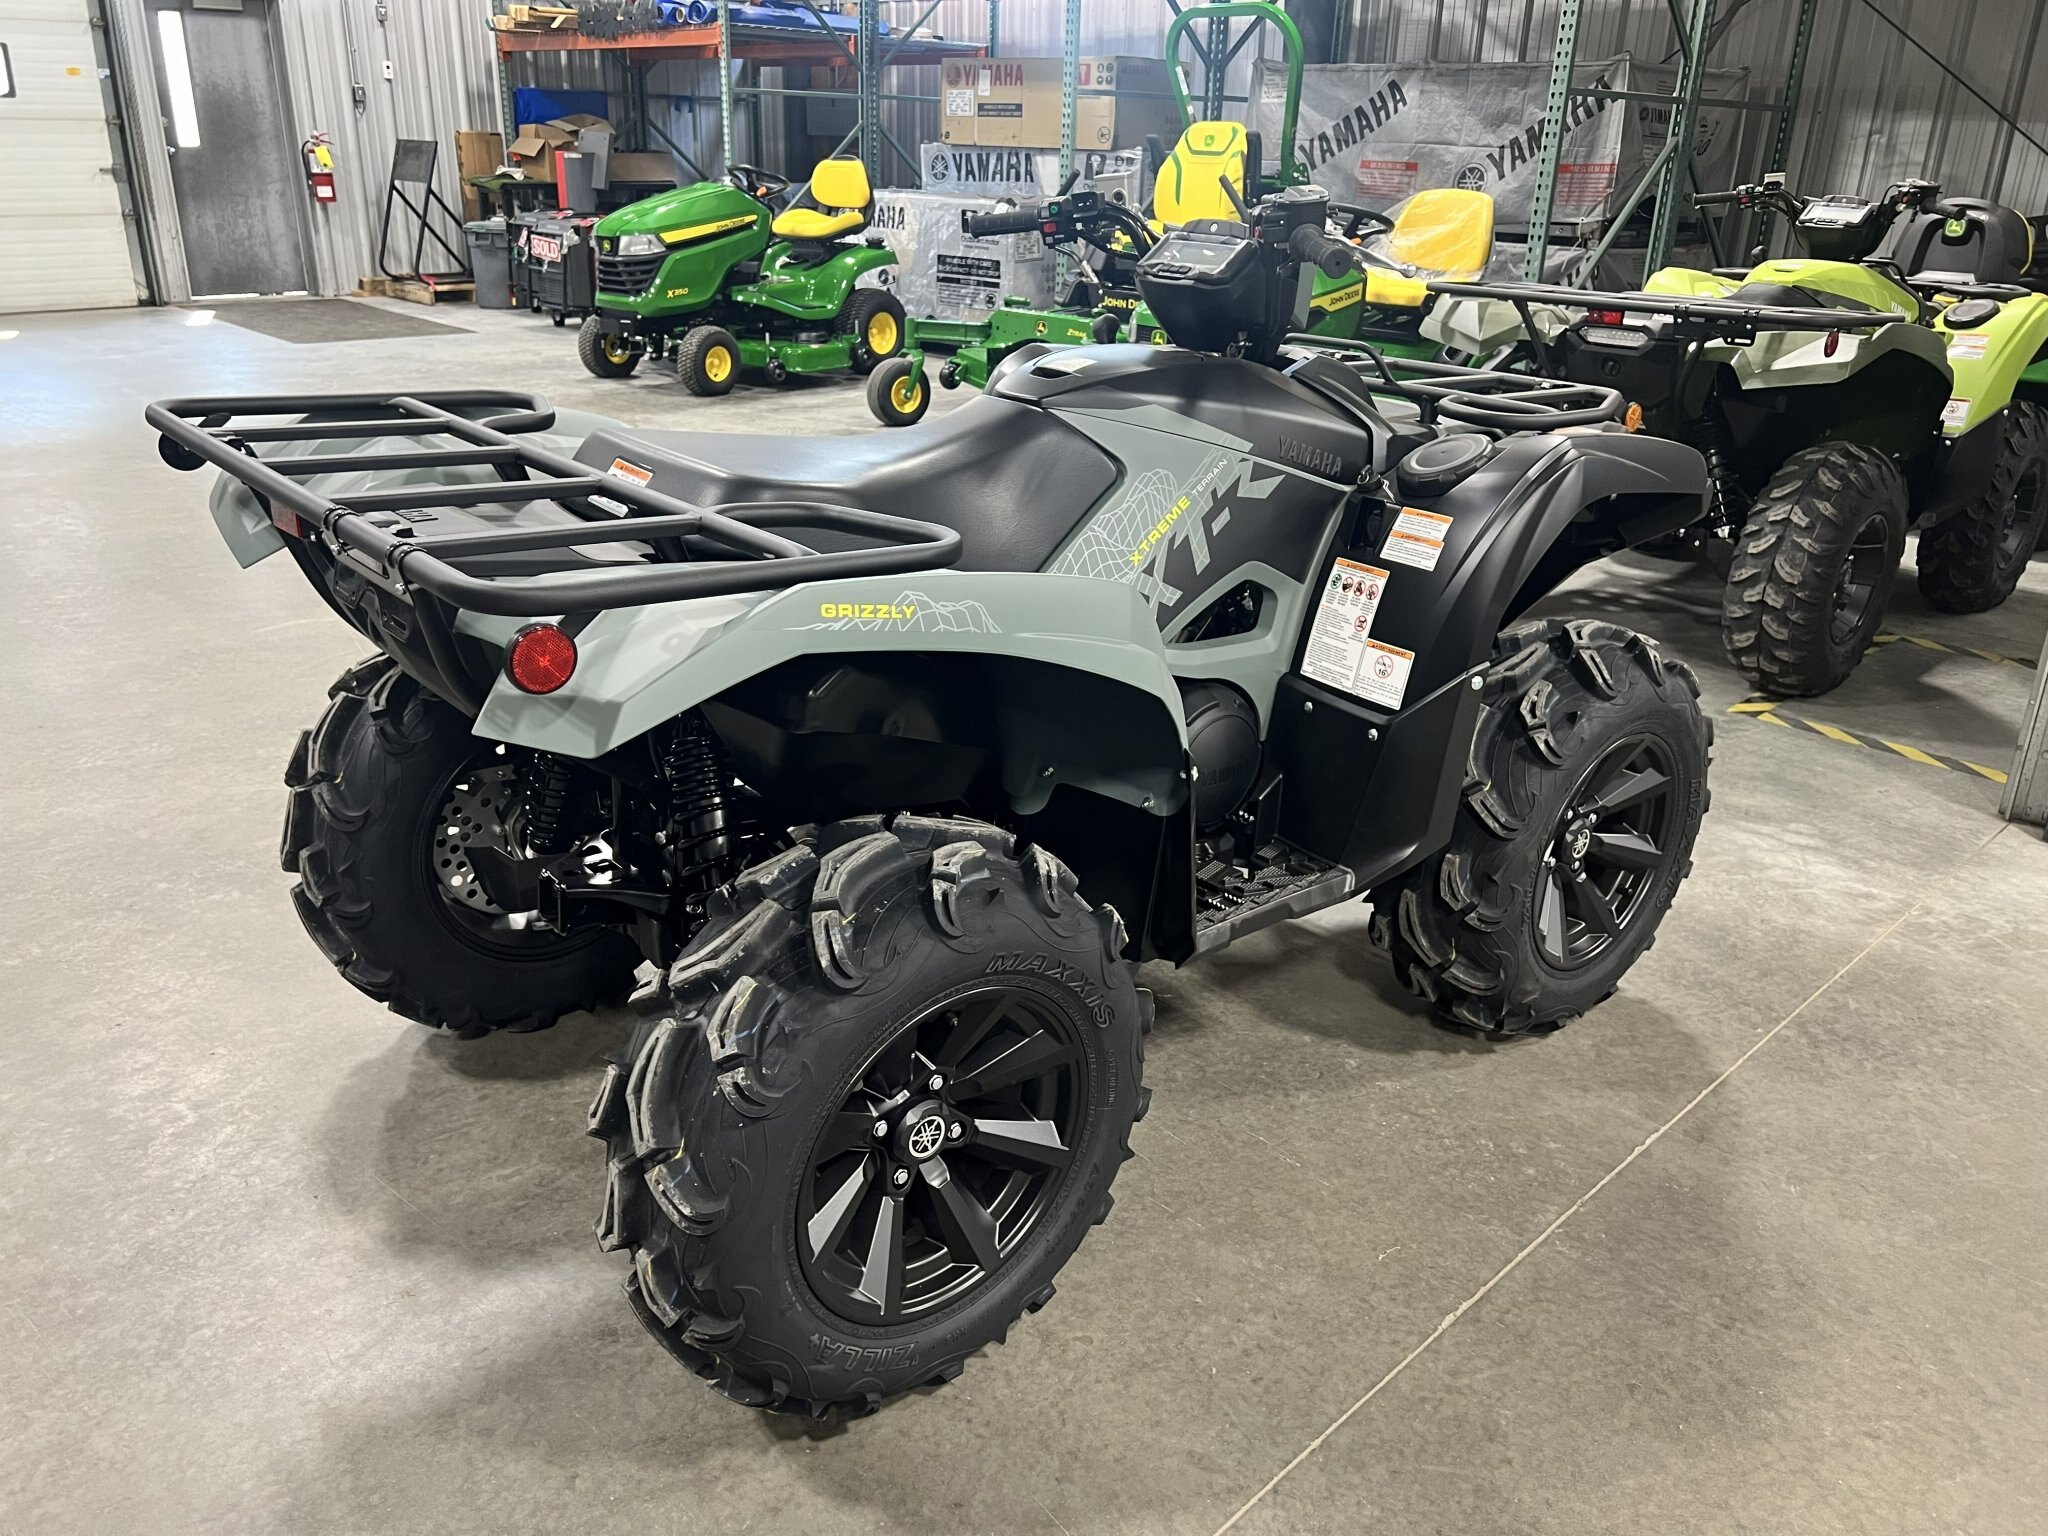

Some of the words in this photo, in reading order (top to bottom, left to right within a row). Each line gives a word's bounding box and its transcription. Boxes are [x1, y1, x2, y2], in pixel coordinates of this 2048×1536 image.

[1298, 79, 1408, 172] YAMAHA
[1486, 75, 1617, 181] YAMHA
[952, 152, 1035, 183] YAMAHA
[533, 238, 559, 260] SOLD
[667, 287, 689, 299] X350
[1102, 296, 1127, 309] JOHN
[1329, 295, 1344, 307] JOHN
[1344, 288, 1360, 301] DEERE
[1280, 435, 1342, 478] YAMAHA
[1129, 495, 1192, 568] XTREME
[1191, 457, 1229, 497] TERRAIN
[820, 603, 916, 619] GRIZZLY
[1378, 668, 1387, 677] 16
[985, 951, 1116, 1028] MAXXIS
